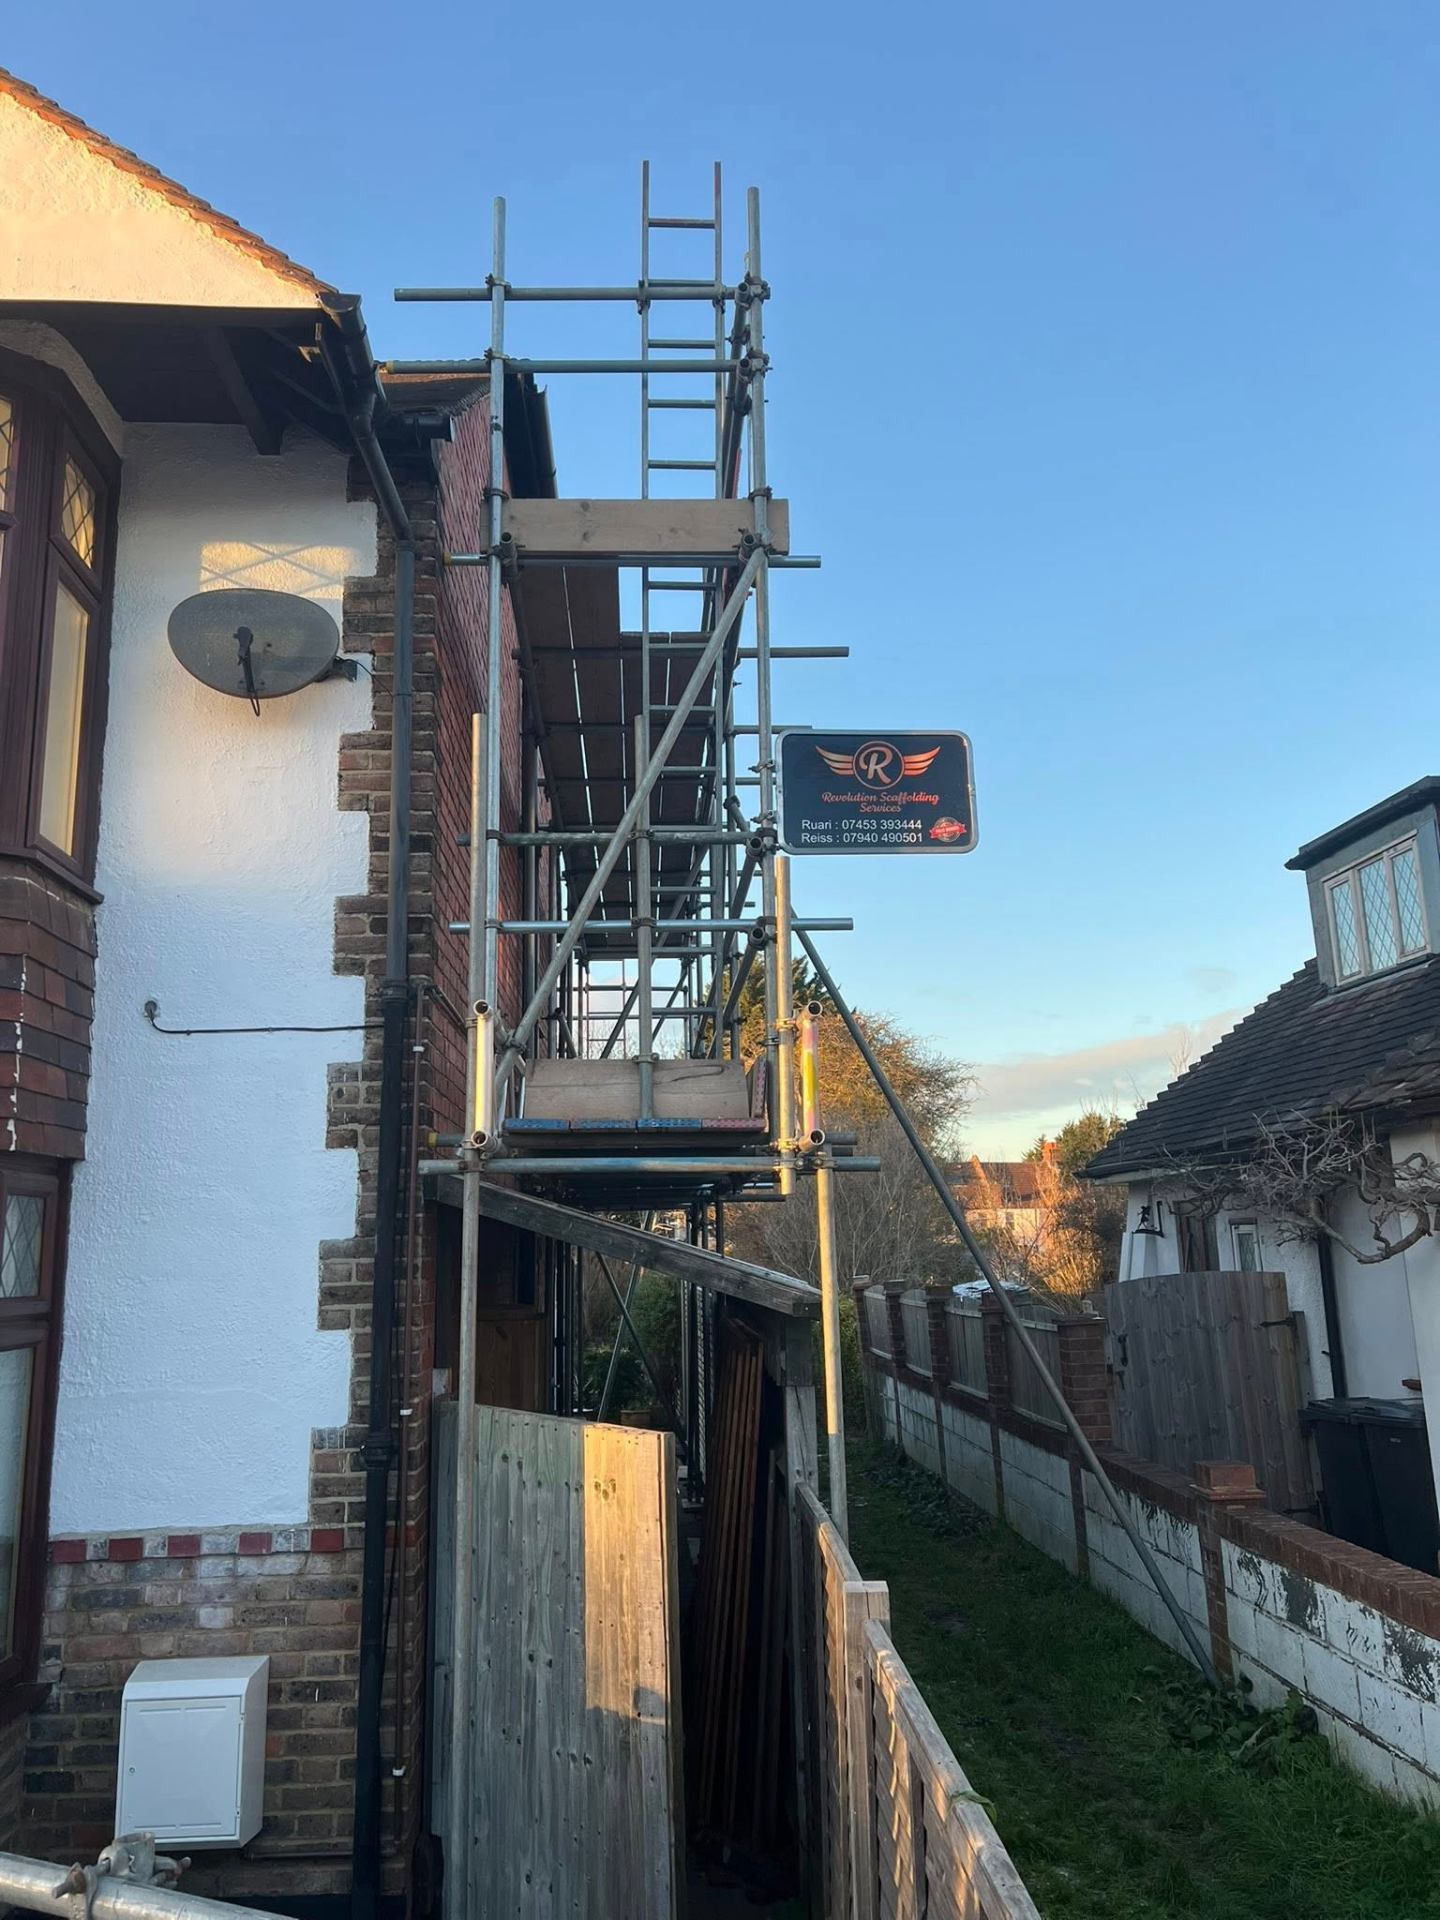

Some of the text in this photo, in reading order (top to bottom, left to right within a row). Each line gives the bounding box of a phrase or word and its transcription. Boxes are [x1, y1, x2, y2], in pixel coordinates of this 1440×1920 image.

[858, 746, 892, 785] R
[821, 791, 940, 805] Revolution Scaffolding
[859, 802, 902, 813] Services
[801, 819, 832, 830] Ruari
[841, 819, 877, 830] 07453
[880, 819, 922, 830] 393444
[801, 832, 833, 843] Reiss
[843, 832, 878, 843] 07940
[881, 832, 923, 843] 490501
